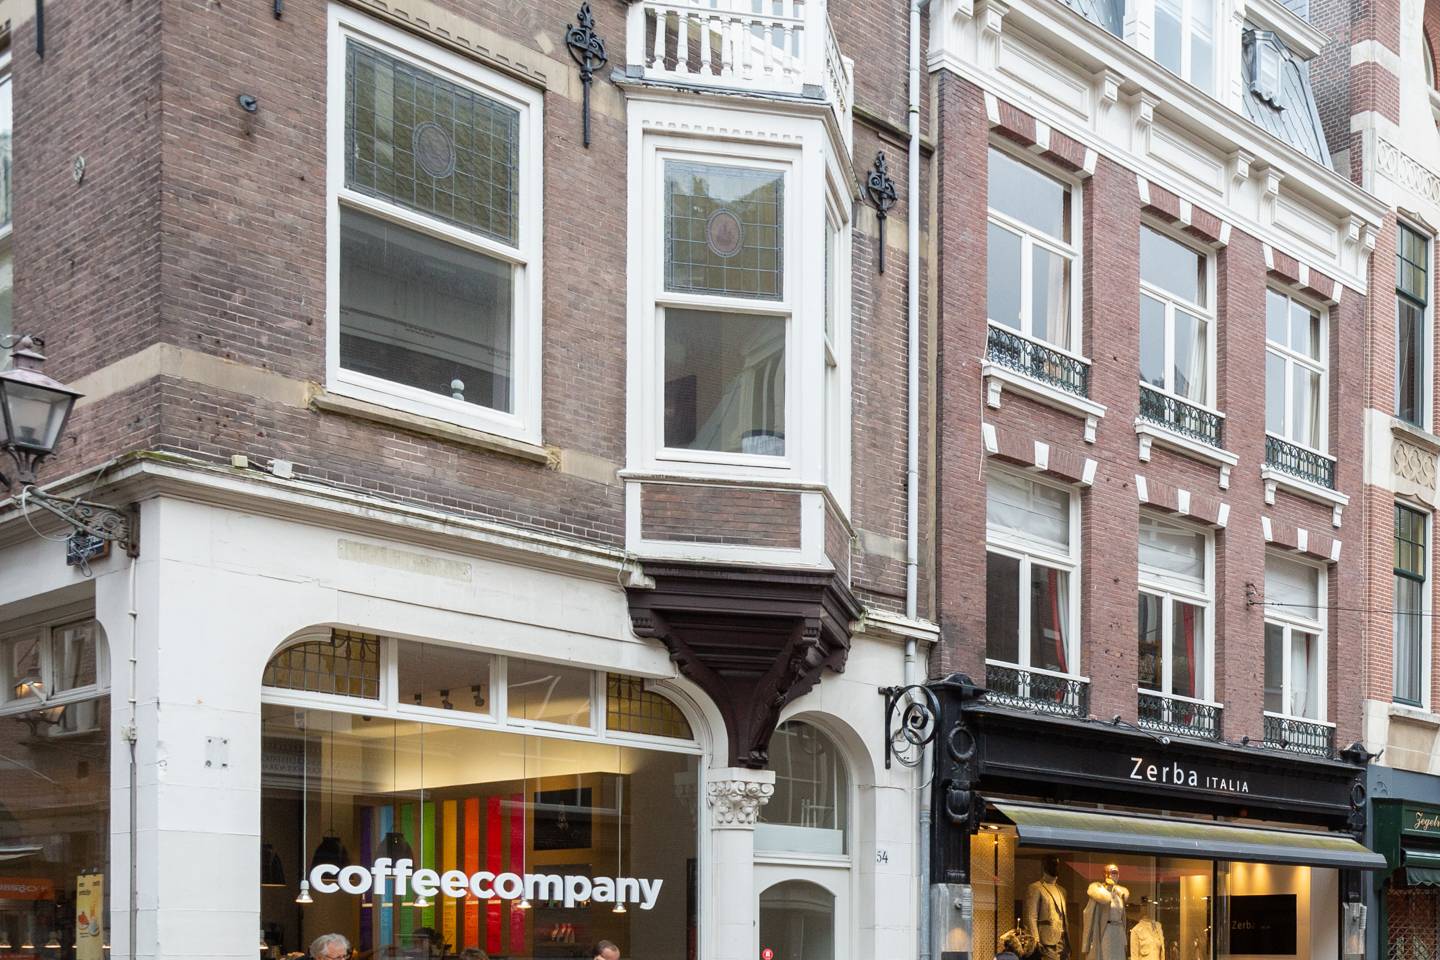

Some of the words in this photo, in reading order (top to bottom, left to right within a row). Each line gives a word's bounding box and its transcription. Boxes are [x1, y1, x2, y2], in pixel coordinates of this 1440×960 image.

[1130, 757, 1198, 787] Zerba
[1206, 776, 1249, 793] ITALIA
[876, 851, 889, 864] 54
[310, 857, 664, 910] coffeecompany
